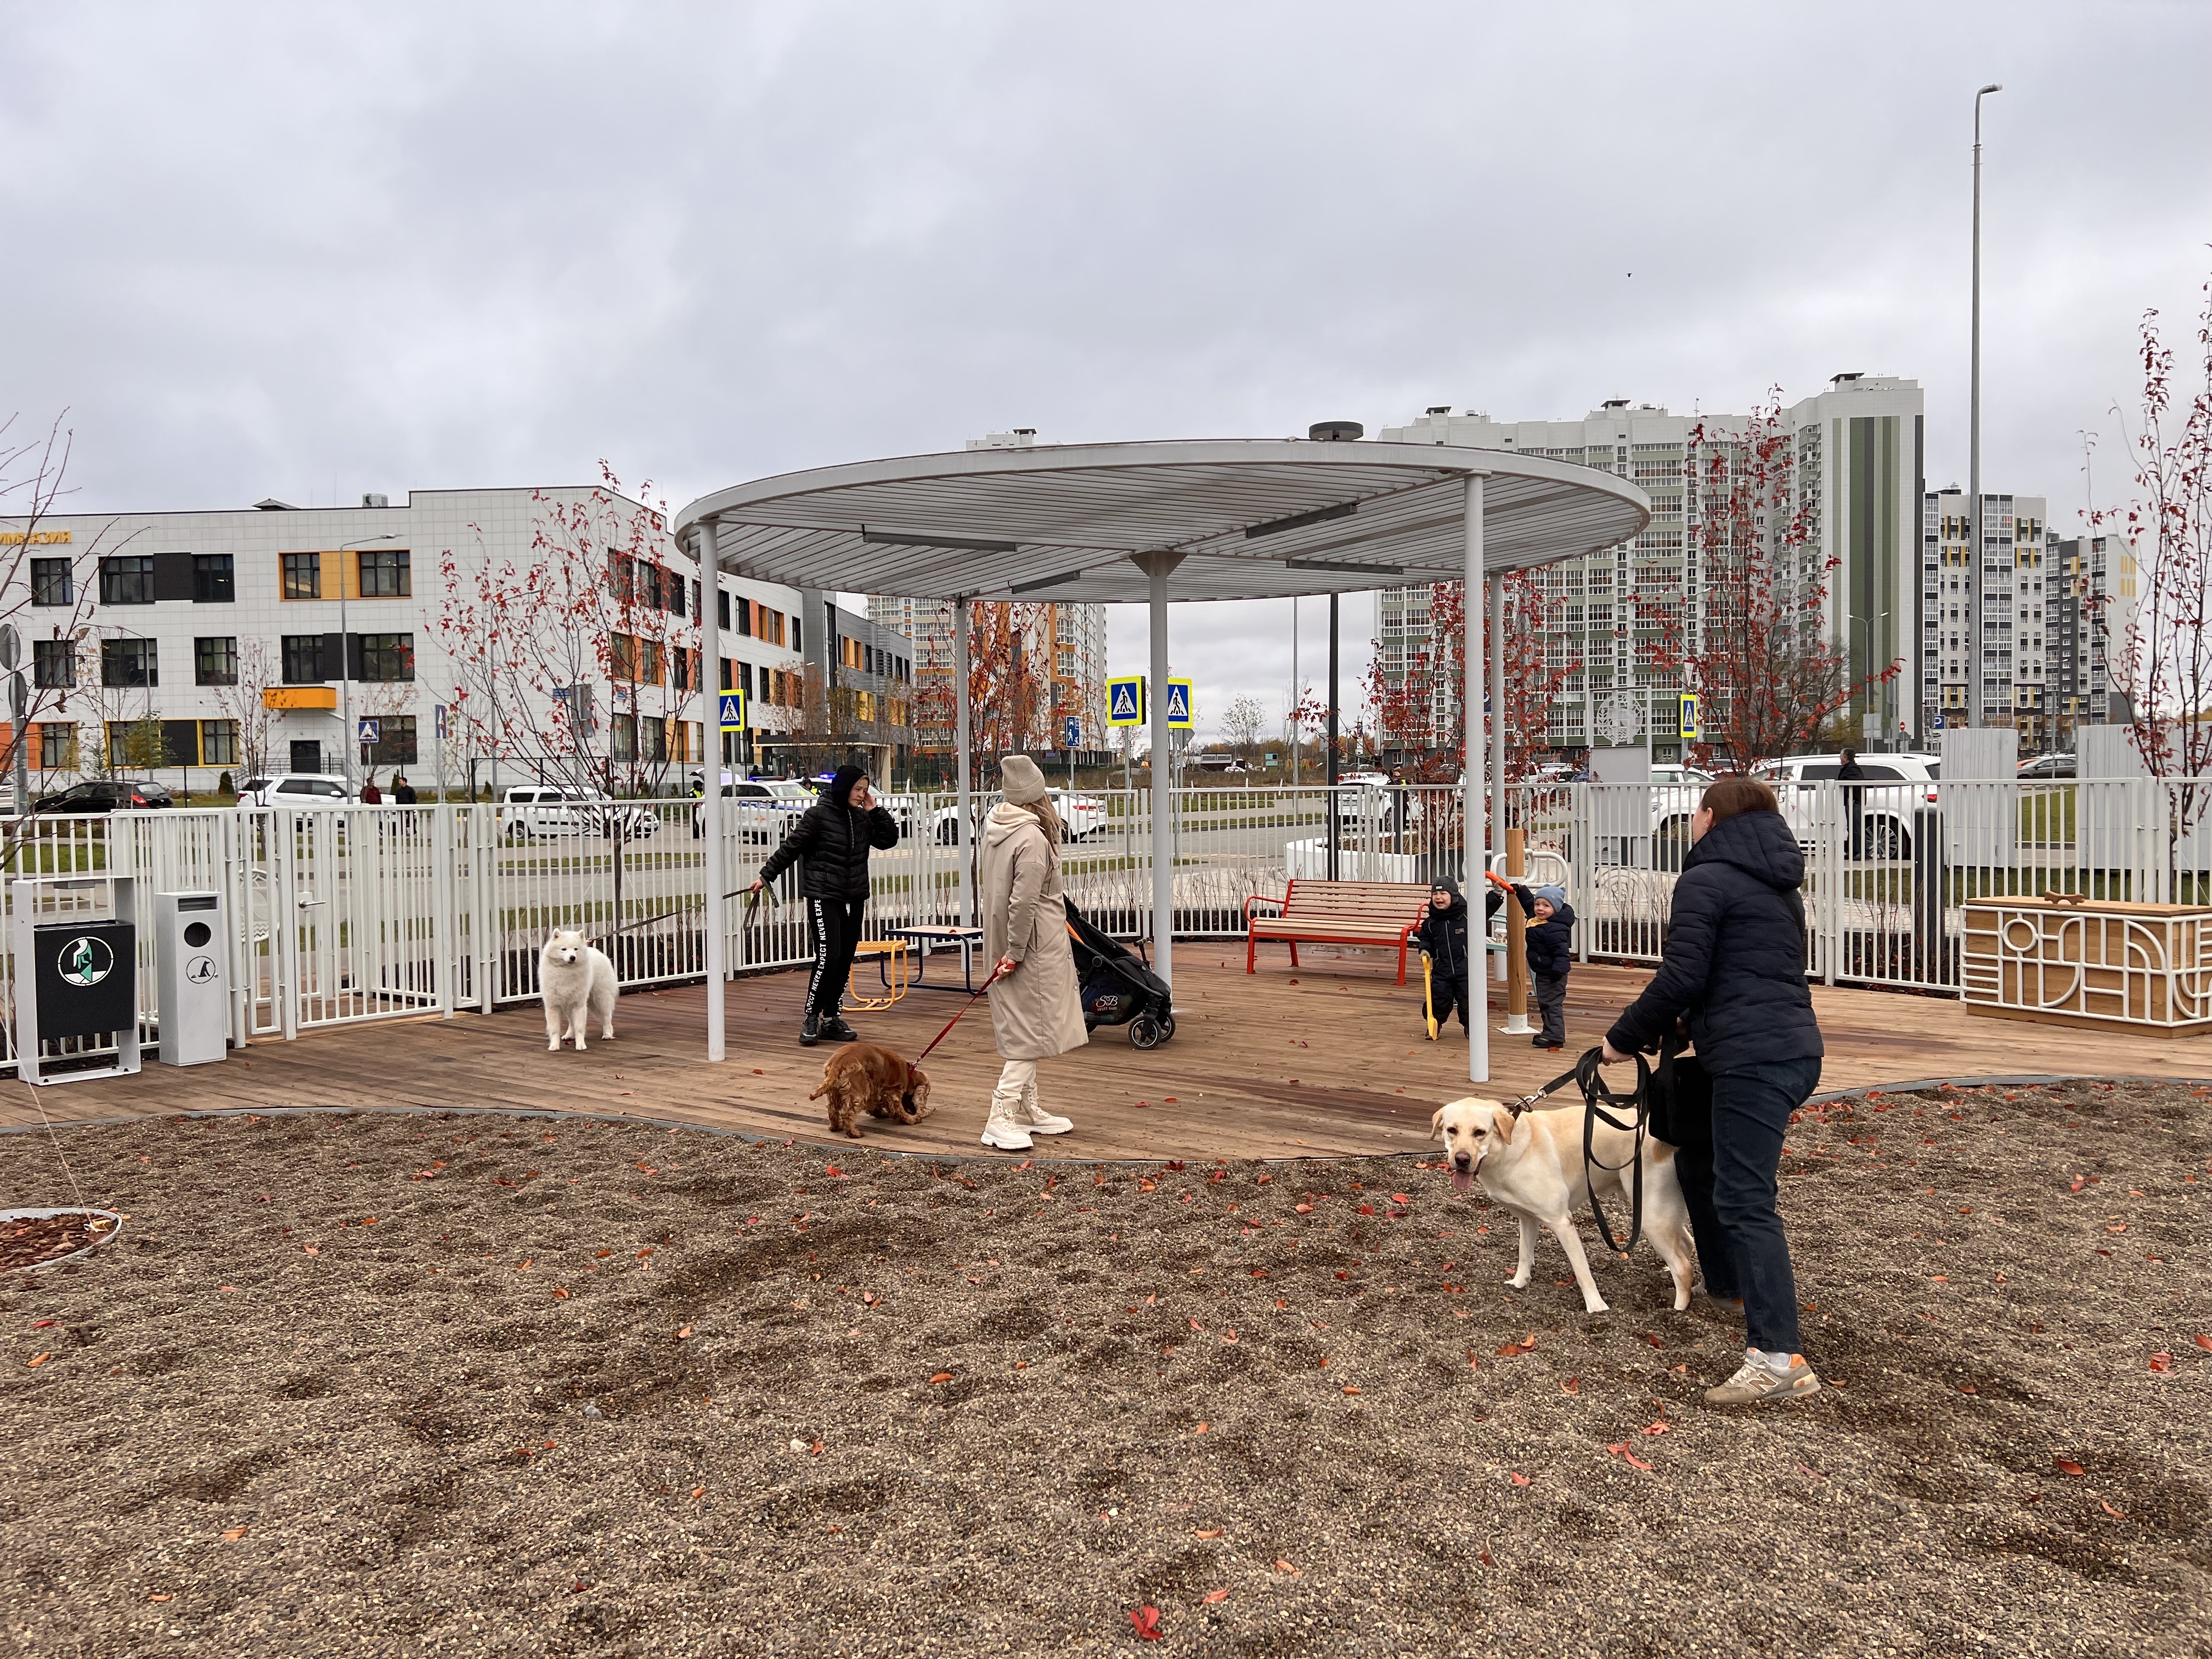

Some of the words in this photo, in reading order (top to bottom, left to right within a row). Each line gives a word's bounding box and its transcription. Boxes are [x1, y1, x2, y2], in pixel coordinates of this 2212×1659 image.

[1934, 716, 1942, 729] P
[816, 918, 826, 940] NEVER
[817, 943, 827, 969] EXPECT
[811, 970, 823, 991] NEVER
[1746, 1372, 1779, 1395] N
